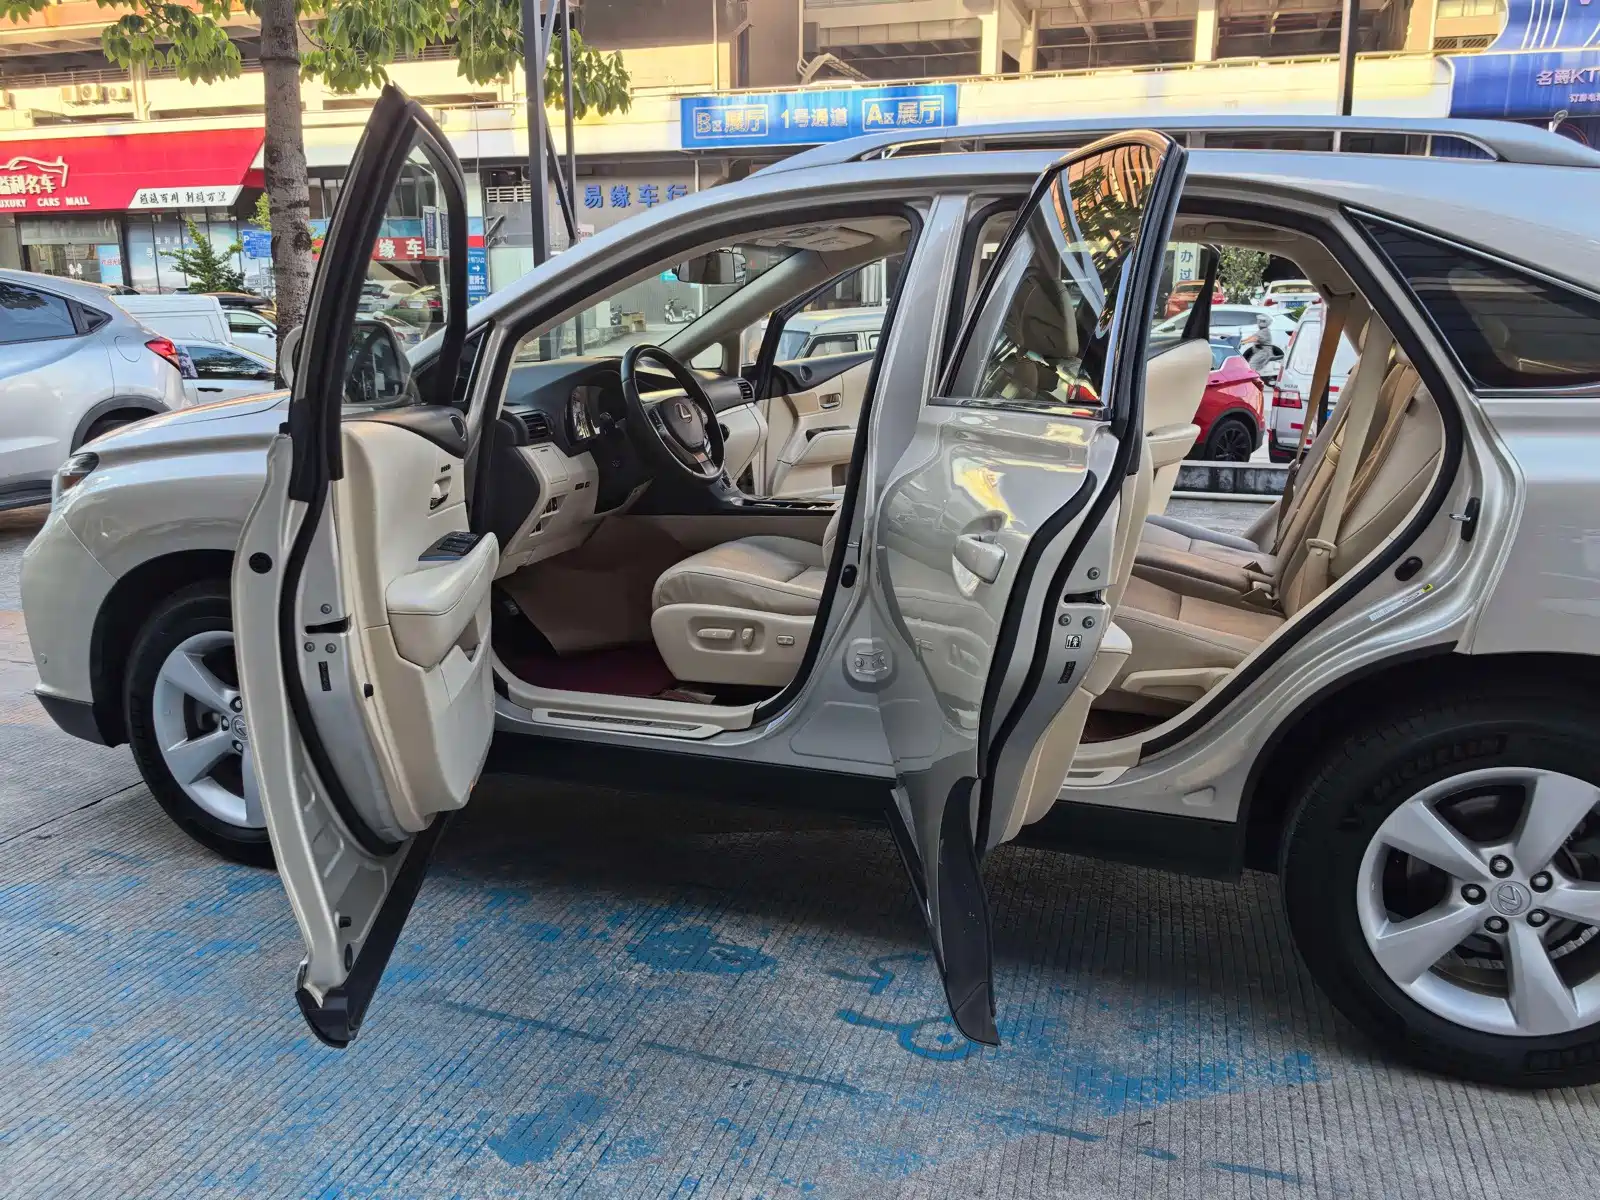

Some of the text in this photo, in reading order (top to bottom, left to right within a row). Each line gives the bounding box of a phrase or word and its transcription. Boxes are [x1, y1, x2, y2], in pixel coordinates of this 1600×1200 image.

[696, 100, 940, 133] B区展厅 1号通道 A区展厅
[0, 196, 91, 208] UXURY CARS MALL
[556, 183, 689, 208] 易缘车行
